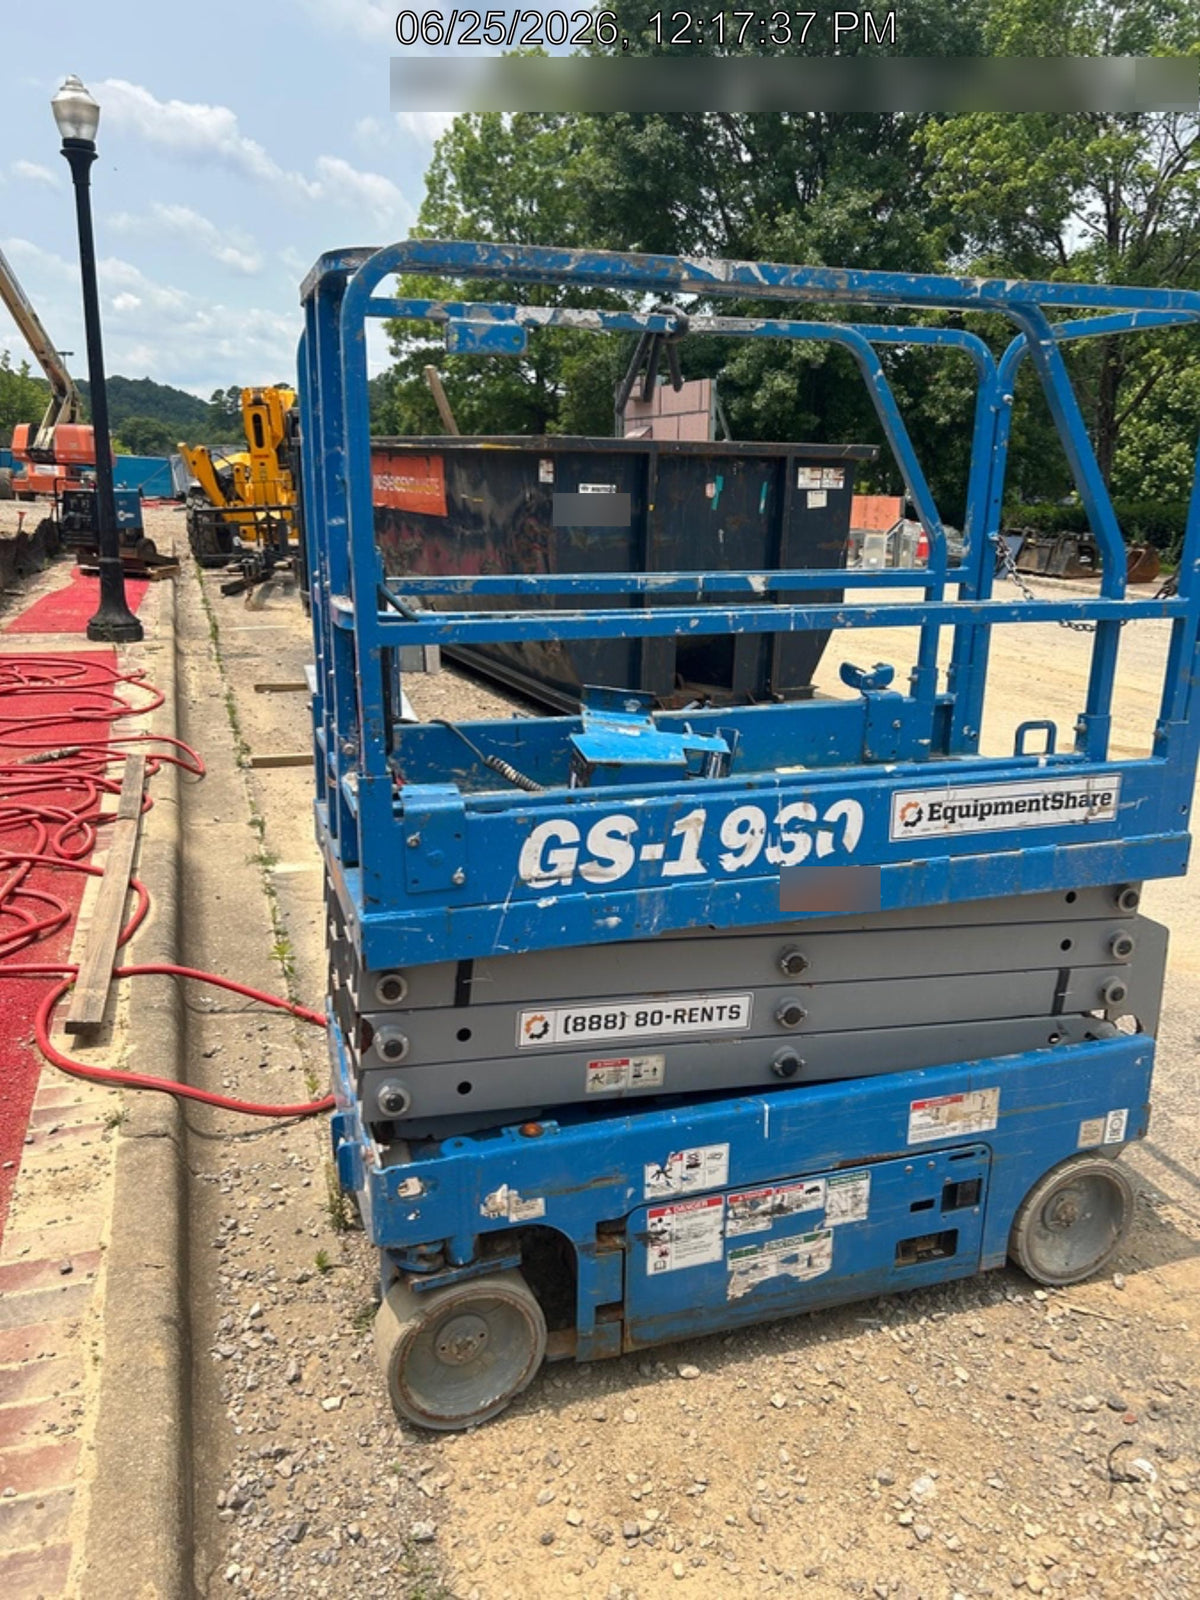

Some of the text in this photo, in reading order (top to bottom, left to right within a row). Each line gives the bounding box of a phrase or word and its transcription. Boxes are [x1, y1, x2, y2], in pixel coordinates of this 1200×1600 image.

[927, 791, 1112, 824] EquipmentShare
[563, 1004, 742, 1035] (888) 80-RENTS
